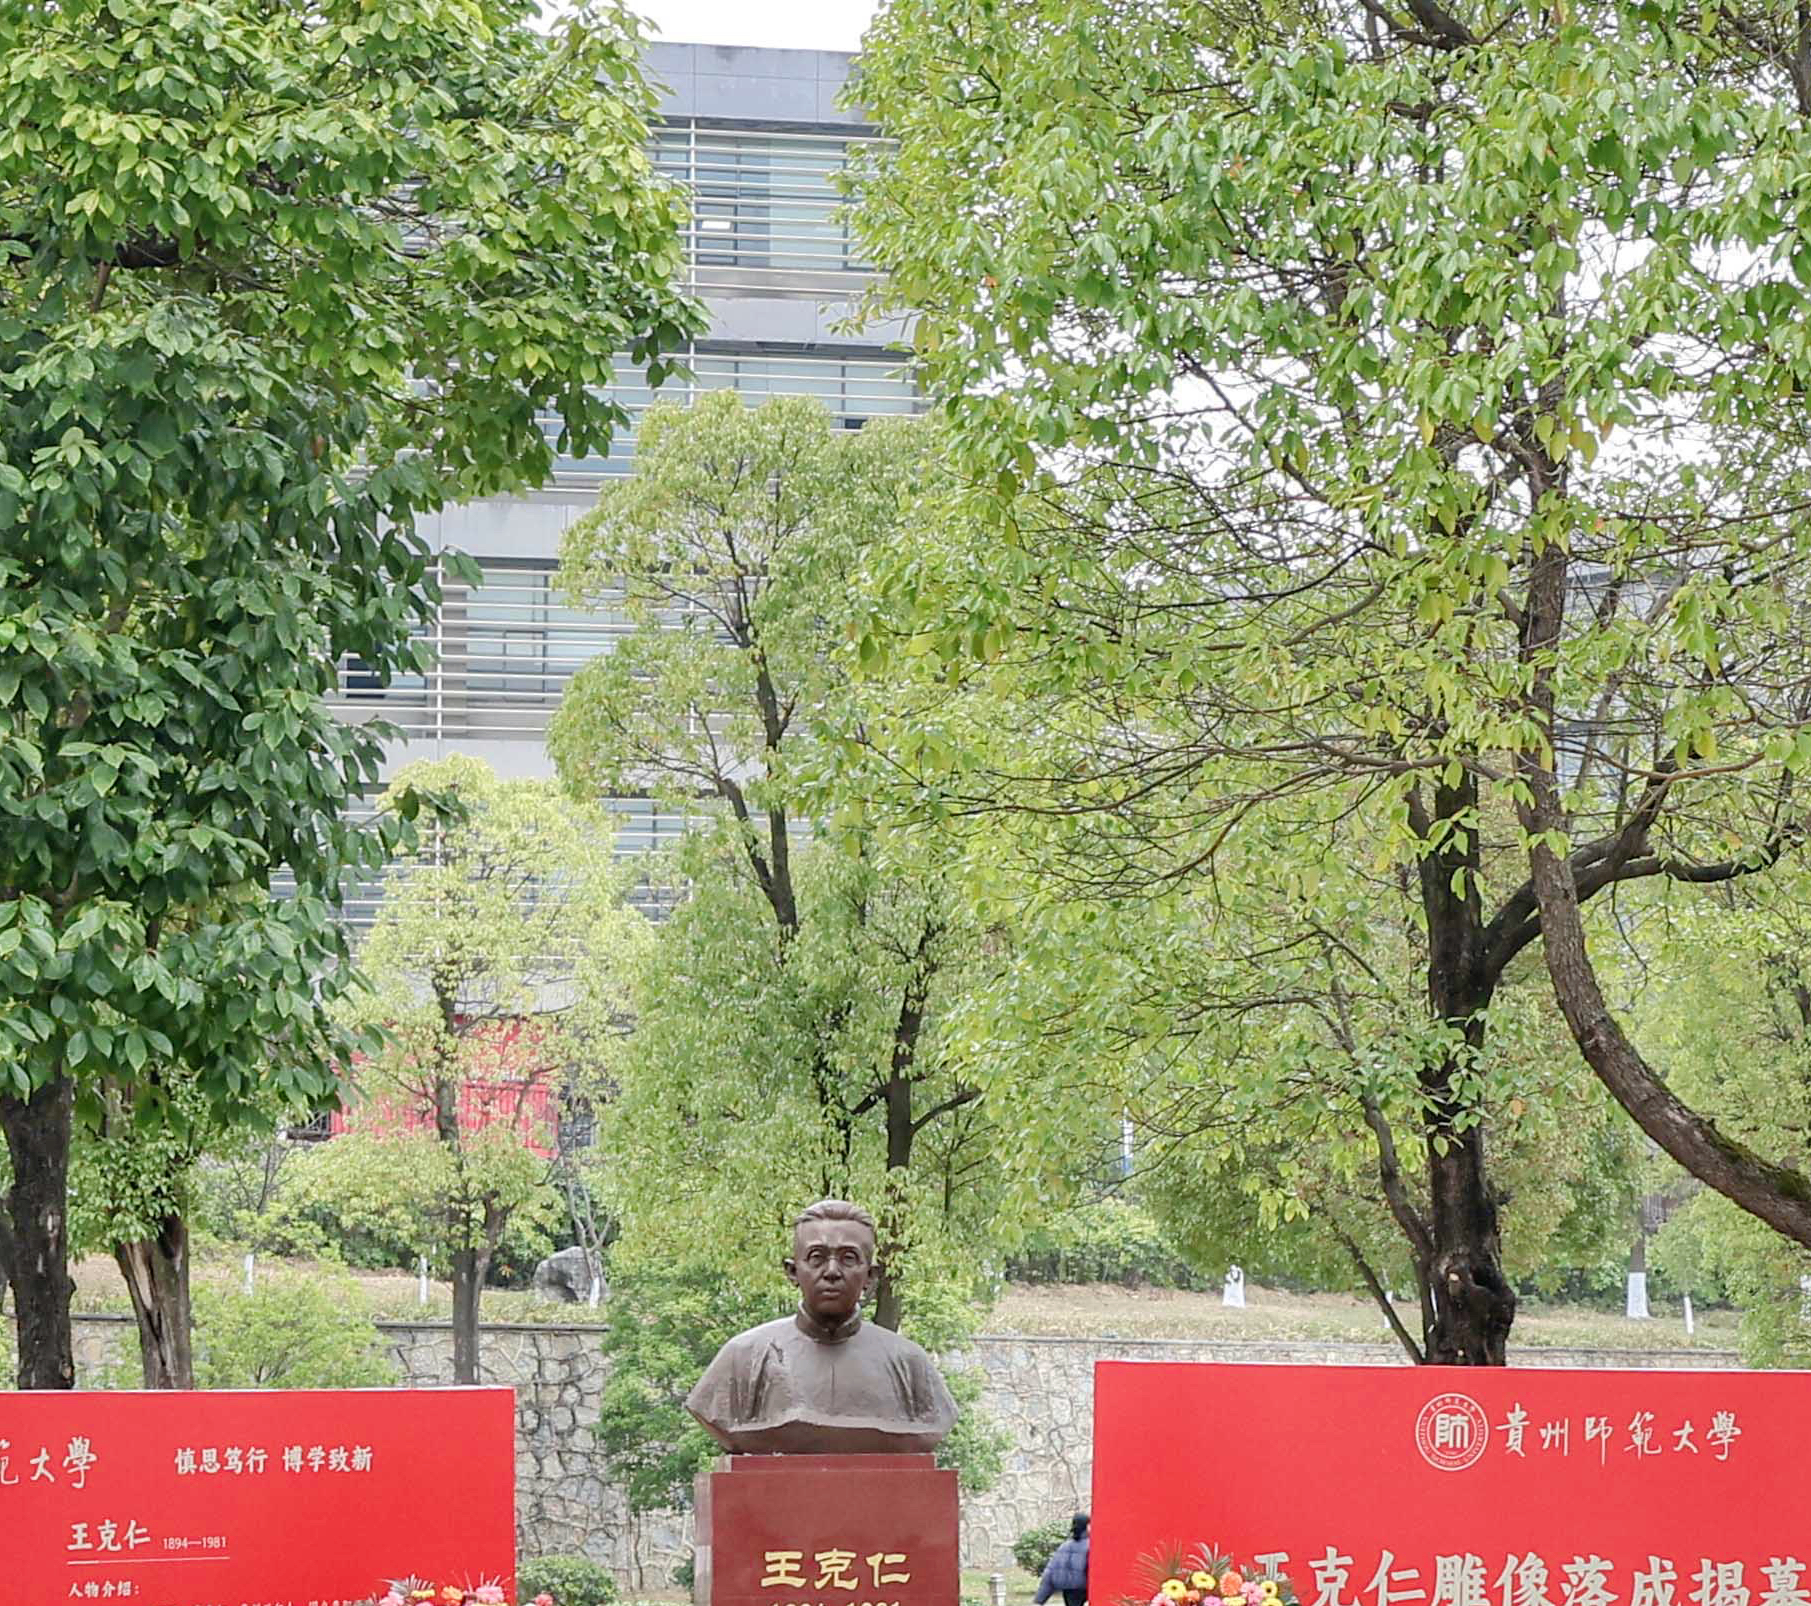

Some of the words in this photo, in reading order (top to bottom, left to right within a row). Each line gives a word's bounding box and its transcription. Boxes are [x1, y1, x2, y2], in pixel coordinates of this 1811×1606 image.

[173, 1446, 269, 1475] 慎思笃行
[281, 1444, 374, 1474] 博学致新
[66, 1518, 152, 1552] 王克仁
[760, 1548, 912, 1591] 王克仁
